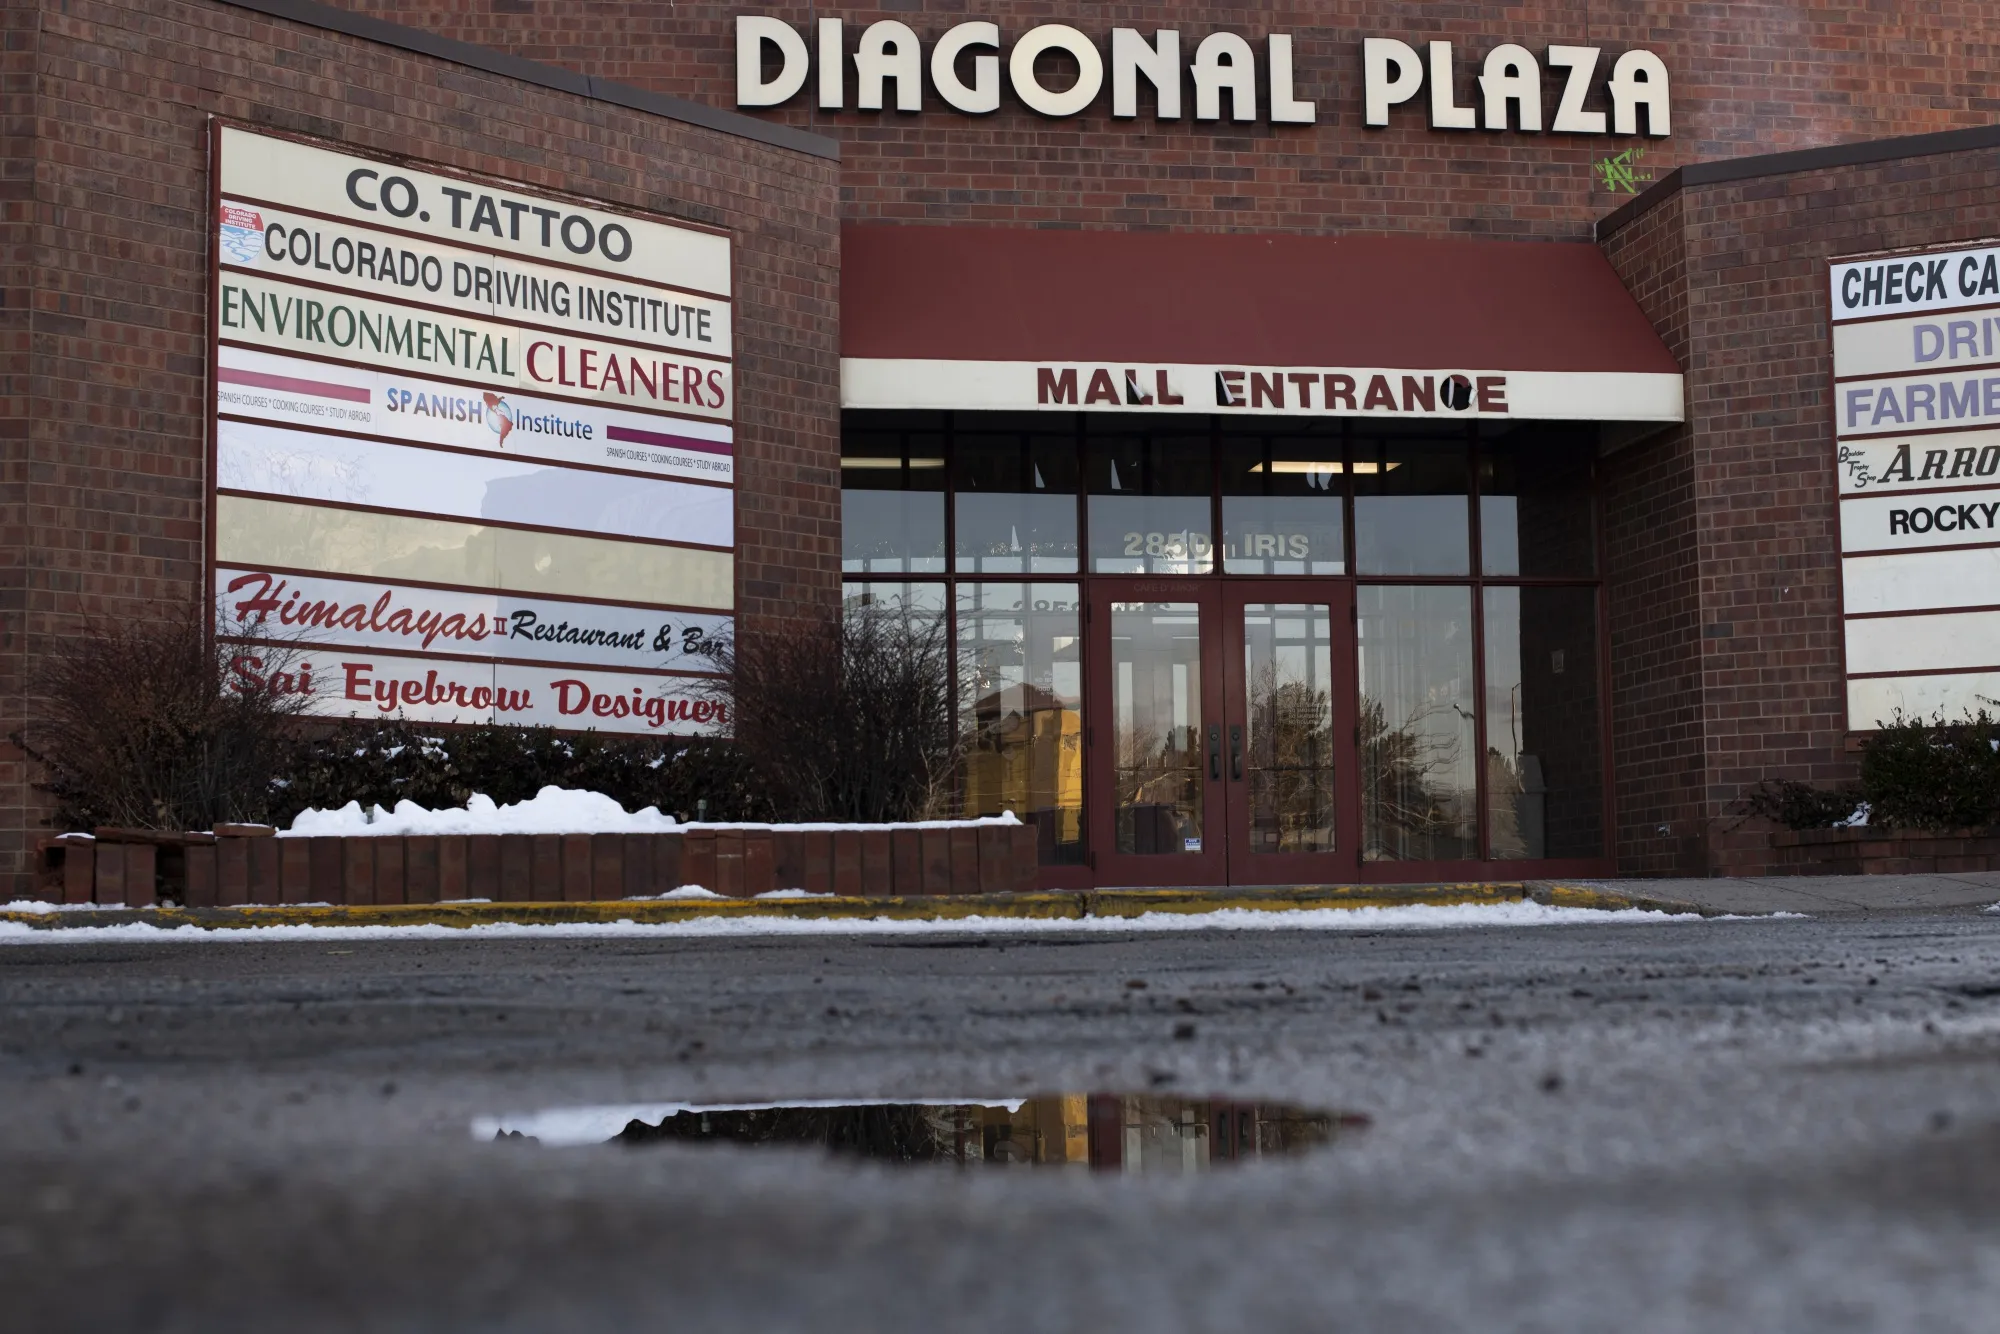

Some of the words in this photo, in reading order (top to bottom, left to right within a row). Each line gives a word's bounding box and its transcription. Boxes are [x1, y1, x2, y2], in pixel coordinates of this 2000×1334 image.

[736, 15, 1316, 124] DIAGONAL
[1362, 37, 1671, 136] PLAZA
[224, 208, 257, 219] COLORADO
[225, 219, 256, 229] INSTITUTE
[228, 214, 253, 224] DRIVING
[345, 168, 431, 223] CO.
[441, 186, 633, 263] TATTOO
[264, 222, 443, 293] COLORADO
[453, 261, 570, 318] DRIVING
[578, 285, 712, 343] INSTITUTE
[1841, 258, 1949, 309] CHECK
[1958, 254, 2000, 298] CA
[221, 284, 515, 377] ENVIRONMENTAL
[526, 341, 725, 409] CLEANERS
[1036, 367, 1184, 406] MALL
[218, 391, 241, 405] SPANISH
[241, 394, 268, 408] COURSES
[272, 399, 299, 413] COOKING
[300, 402, 325, 416] COURSES
[329, 406, 347, 419] STUDY
[348, 409, 371, 423] ABROAD
[386, 387, 482, 424] SPANISH
[516, 408, 593, 440] Institute
[606, 446, 626, 459] SPANISH
[626, 449, 648, 462] COURSES
[651, 453, 673, 465] COOKING
[672, 456, 693, 468] COURSES
[696, 459, 711, 470] STUDY
[711, 461, 731, 473] ABROAD
[1847, 460, 1870, 477] Trophy
[1877, 443, 2000, 483] ARRO
[1854, 471, 1877, 488] Shop
[1889, 501, 2000, 535] ROCKY
[1123, 531, 1212, 558] 2850
[1244, 533, 1309, 559] IRIS
[227, 573, 491, 650] Himalayas
[510, 609, 645, 650] Restaurant
[652, 624, 671, 652] &
[682, 626, 724, 657] Bar
[229, 655, 316, 697] Sai
[341, 662, 533, 713] Eyebrow
[550, 679, 729, 728] Designer
